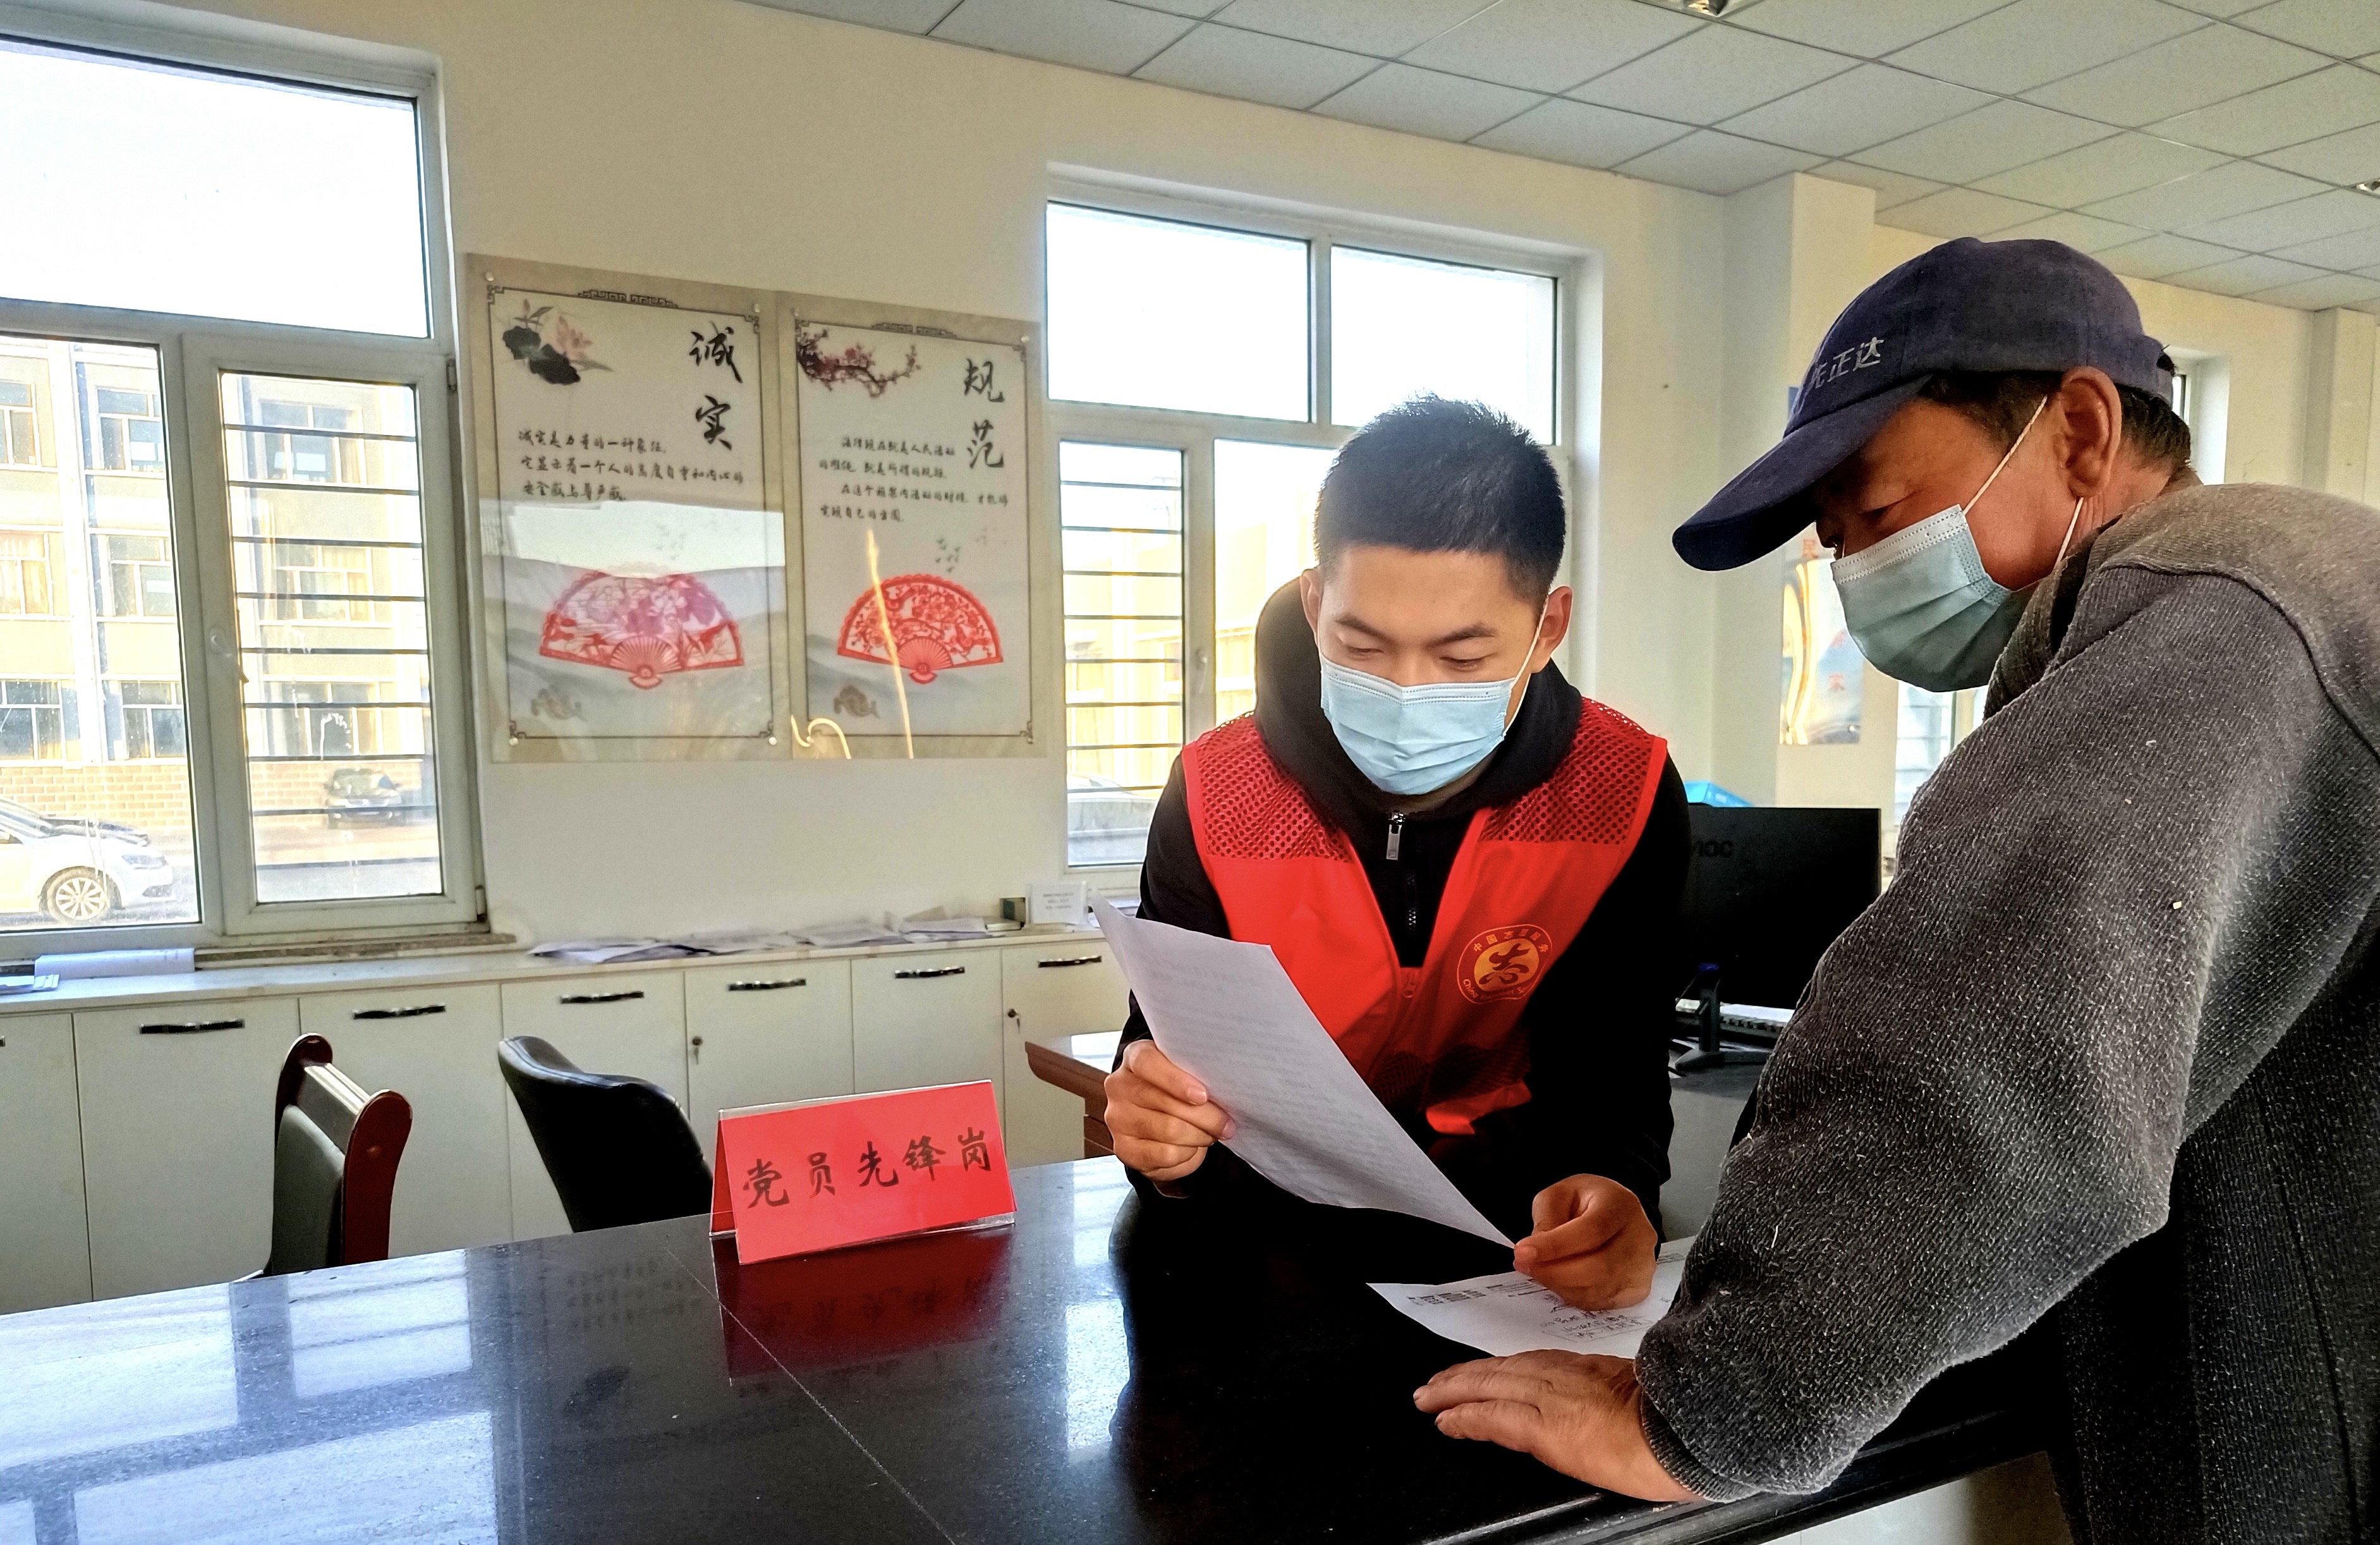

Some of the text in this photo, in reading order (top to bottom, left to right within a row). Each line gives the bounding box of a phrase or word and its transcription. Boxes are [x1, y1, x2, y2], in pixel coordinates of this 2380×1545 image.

[689, 321, 743, 450] 诚实
[964, 358, 1004, 469] 规范
[743, 1127, 992, 1209] 党员先锋岗
